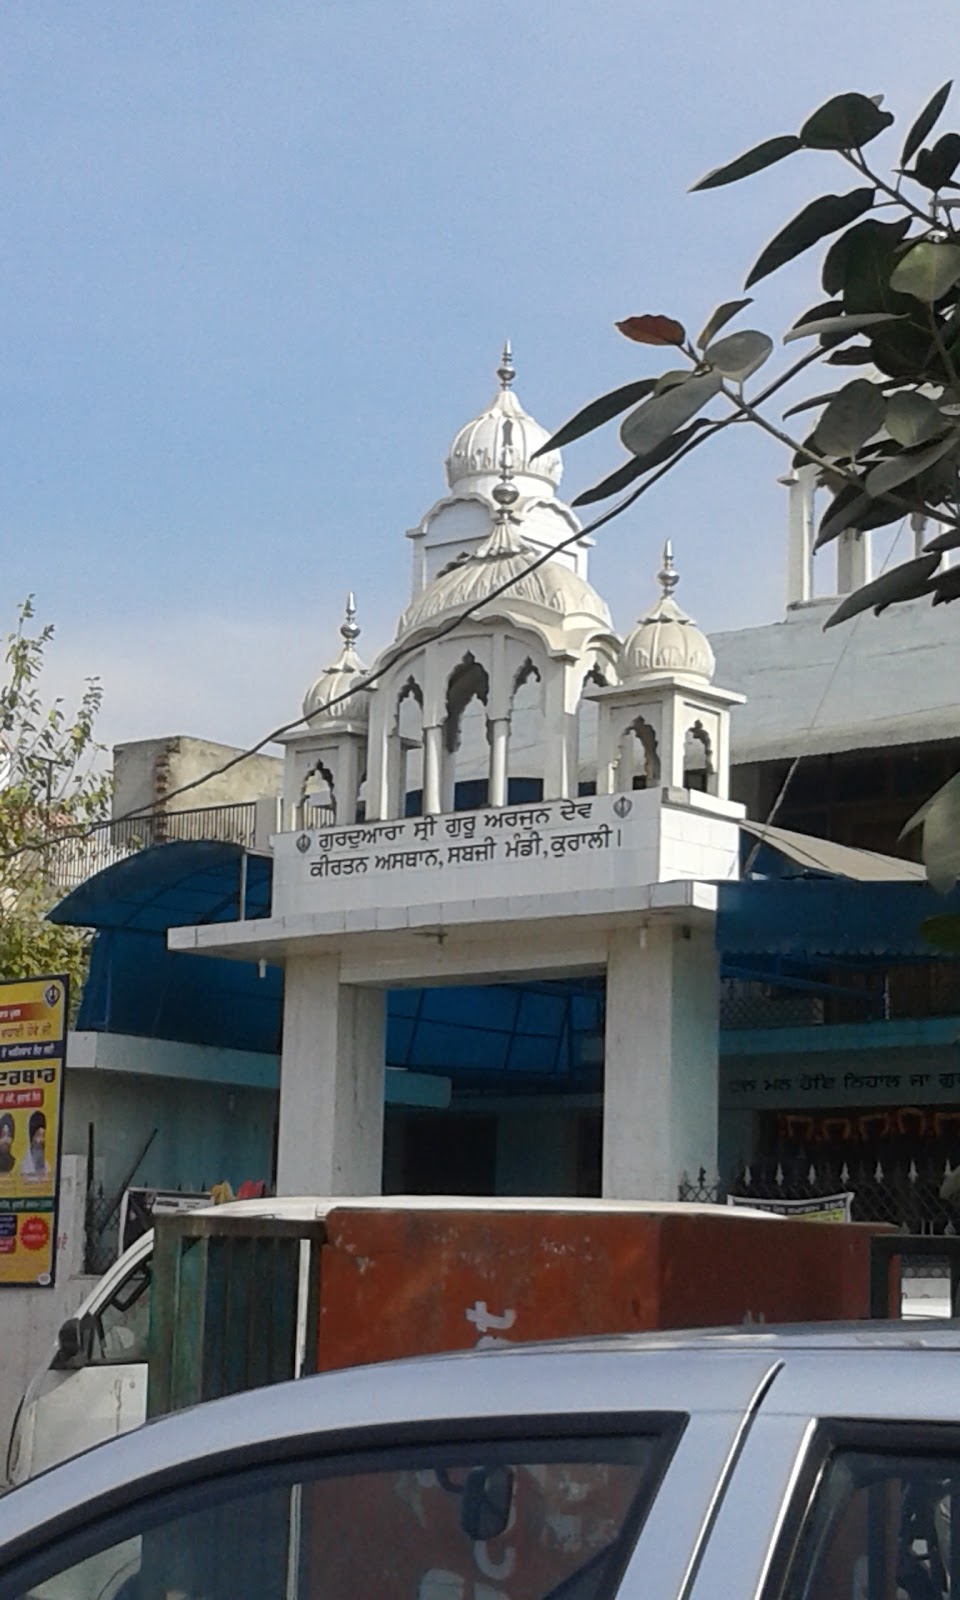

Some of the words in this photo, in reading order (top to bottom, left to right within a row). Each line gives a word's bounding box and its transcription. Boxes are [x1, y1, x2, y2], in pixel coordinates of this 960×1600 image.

[319, 825, 405, 851] ਗੁਰਦੁਆਰਾ
[413, 815, 438, 841] ਸ੍ਰੀ
[445, 816, 476, 838] ਗੁਰੂ
[485, 808, 552, 830] ਅਰਜੁਨ
[560, 799, 593, 821] ਦੇਵ
[310, 854, 370, 877] ਕੀਰਤਨ
[374, 848, 444, 870] ਅਸਥਾਨ,
